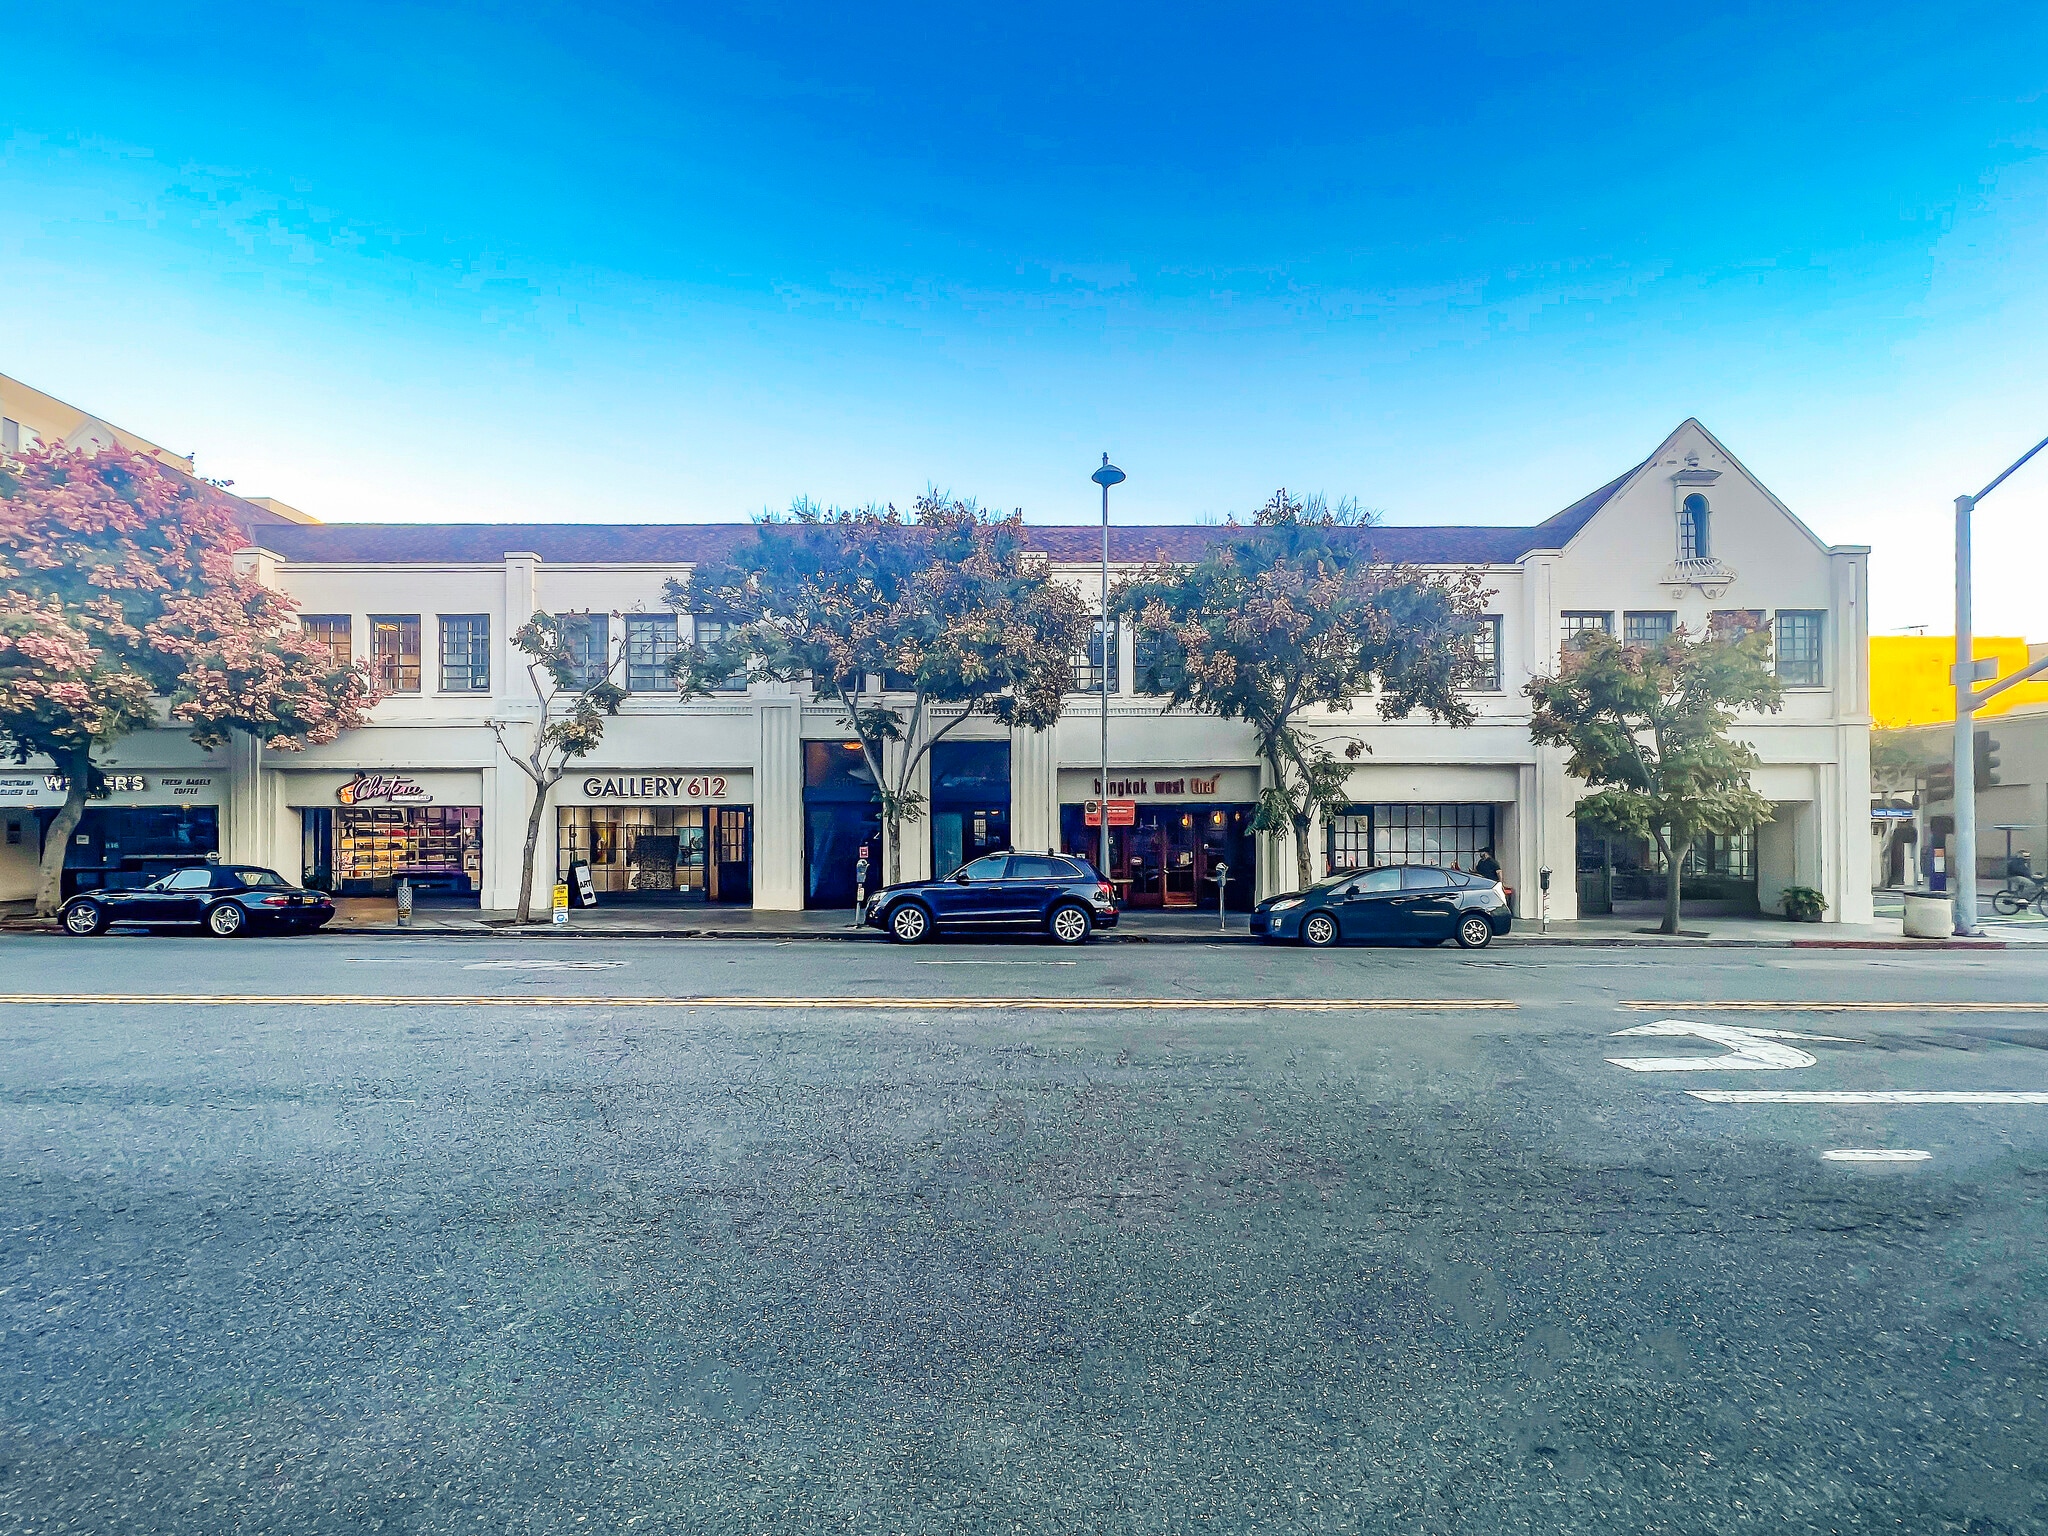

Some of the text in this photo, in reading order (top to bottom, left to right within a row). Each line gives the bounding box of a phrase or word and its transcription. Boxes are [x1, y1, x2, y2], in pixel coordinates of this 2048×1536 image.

[43, 776, 144, 790] WEER'S
[354, 774, 424, 802] Chateau
[582, 776, 728, 797] GALLERY 612
[1094, 773, 1221, 796] bngkok west thai
[580, 880, 591, 888] ART
